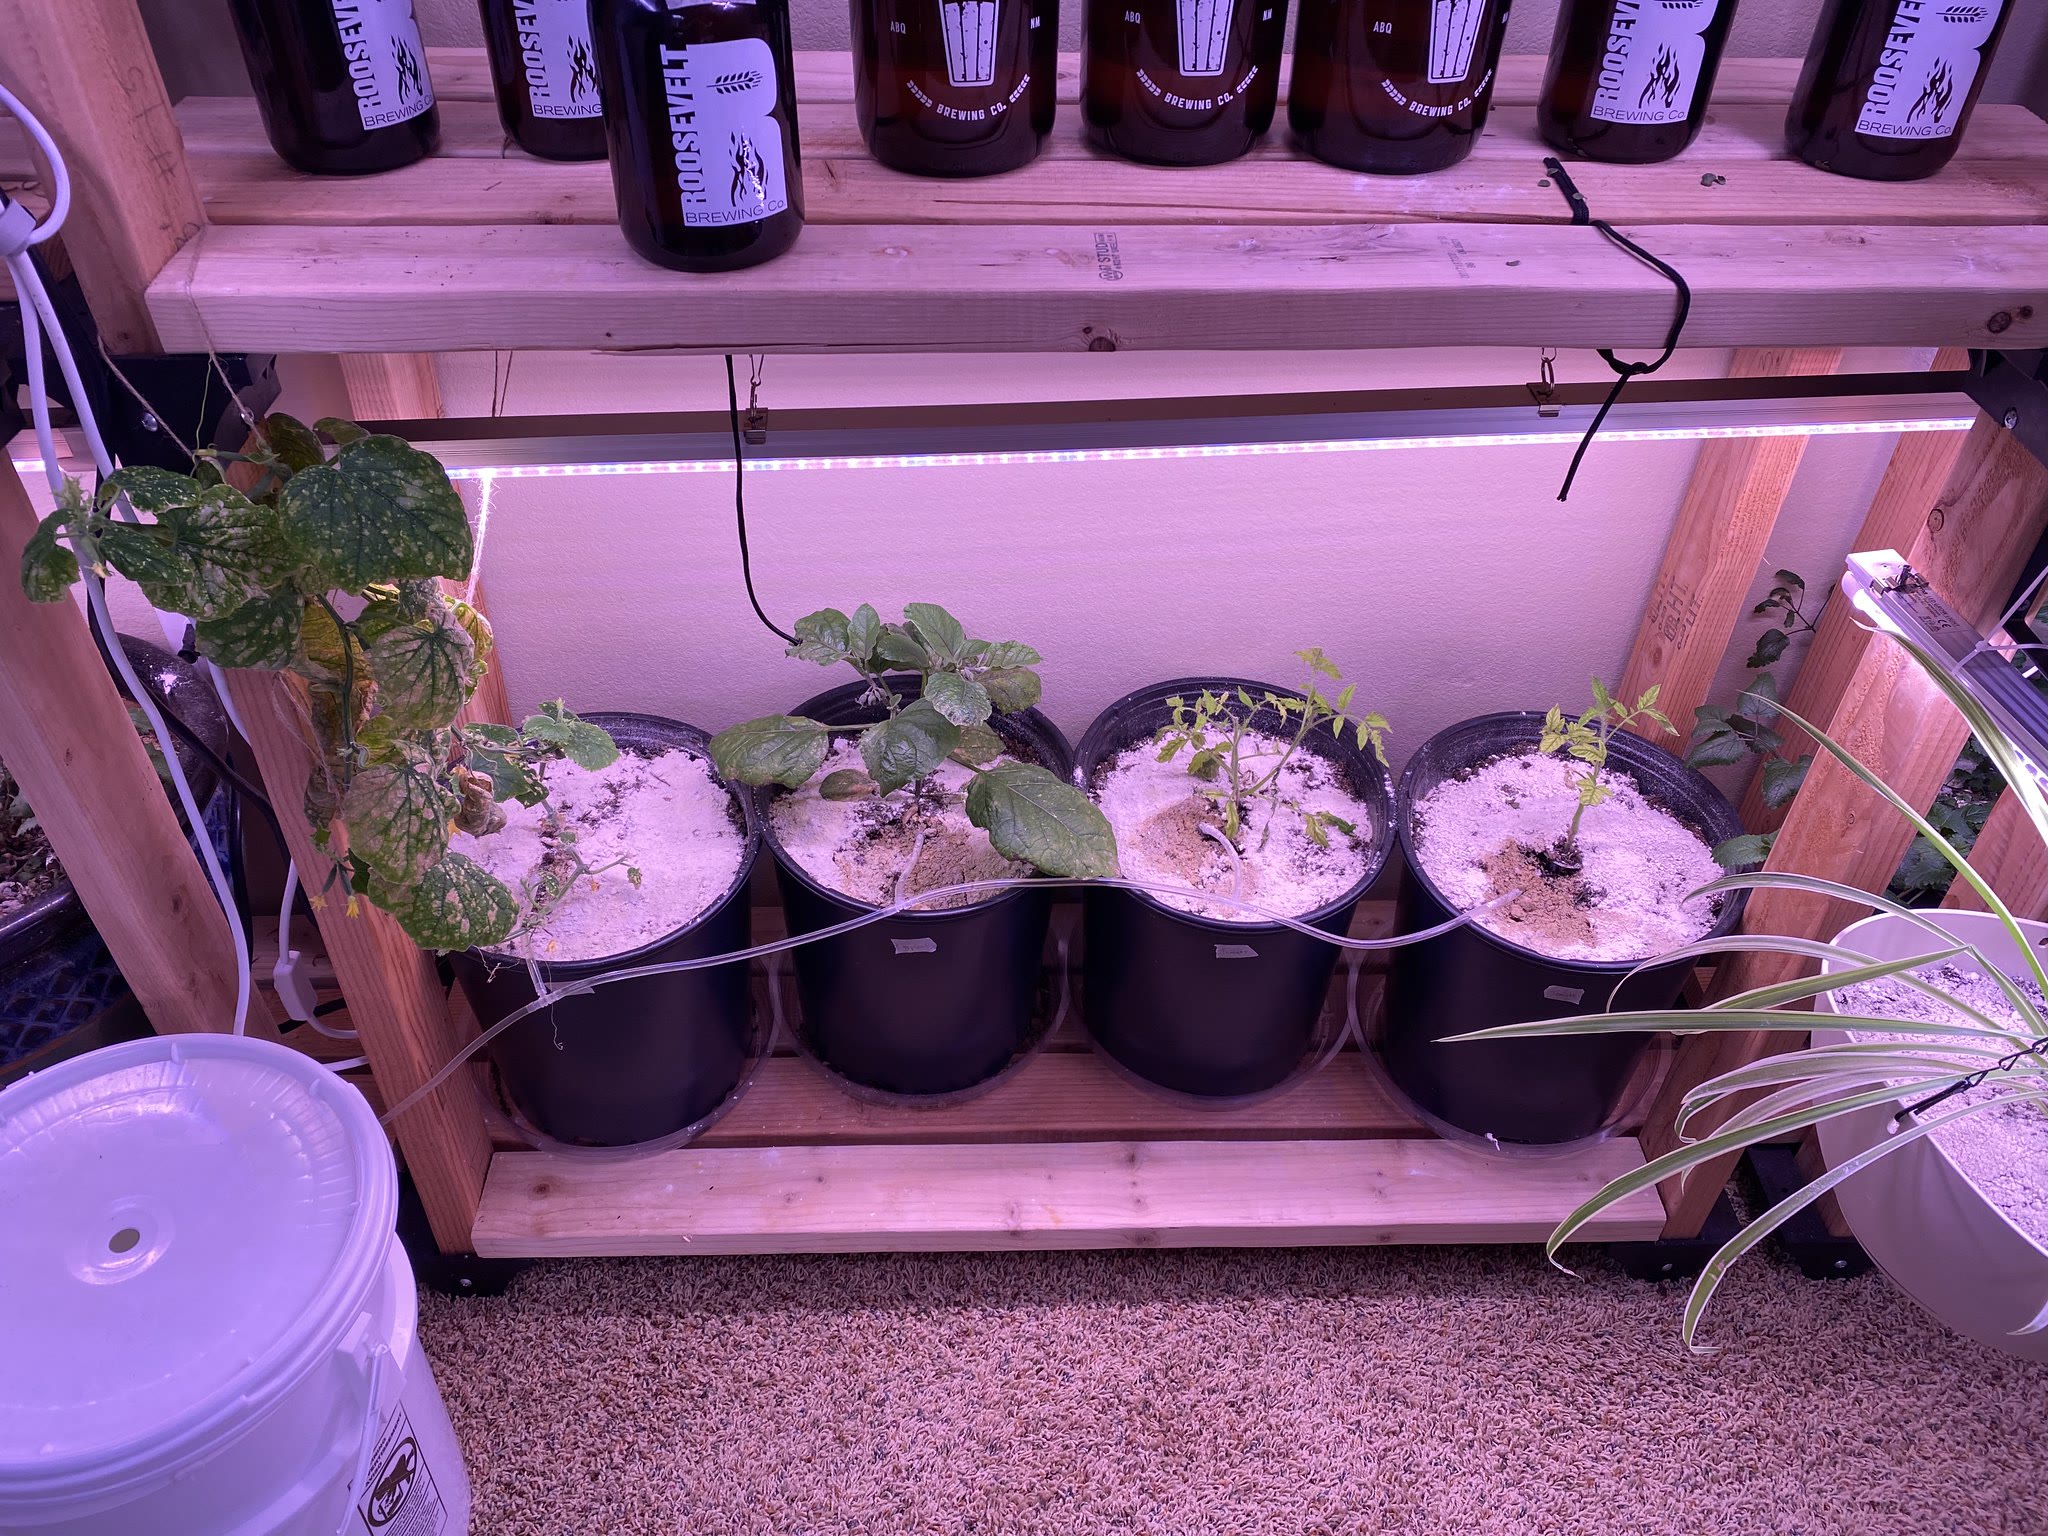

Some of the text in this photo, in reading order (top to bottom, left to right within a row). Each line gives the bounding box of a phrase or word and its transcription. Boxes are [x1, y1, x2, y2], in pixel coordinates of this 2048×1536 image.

[1031, 16, 1040, 29] NM
[1125, 10, 1141, 24] ABQ
[890, 21, 906, 34] ABQ
[1373, 21, 1392, 34] ABQ
[1595, 0, 1640, 101] ROOSEV
[1862, 0, 1925, 115] ROOSEVE
[534, 104, 602, 116] BREWING
[1164, 92, 1234, 110] BREWING CO.
[1409, 97, 1471, 117] BREWING CO.
[364, 98, 424, 127] BREWING
[937, 102, 1007, 121] BREWING CO.
[1593, 106, 1664, 120] BREWING
[660, 44, 707, 204] ROOSEVELT
[1858, 120, 1932, 136] BREWING
[686, 205, 763, 223] BREWING
[1095, 243, 1111, 263] STUD
[368, 1411, 402, 1477] VERTISSEMENT
